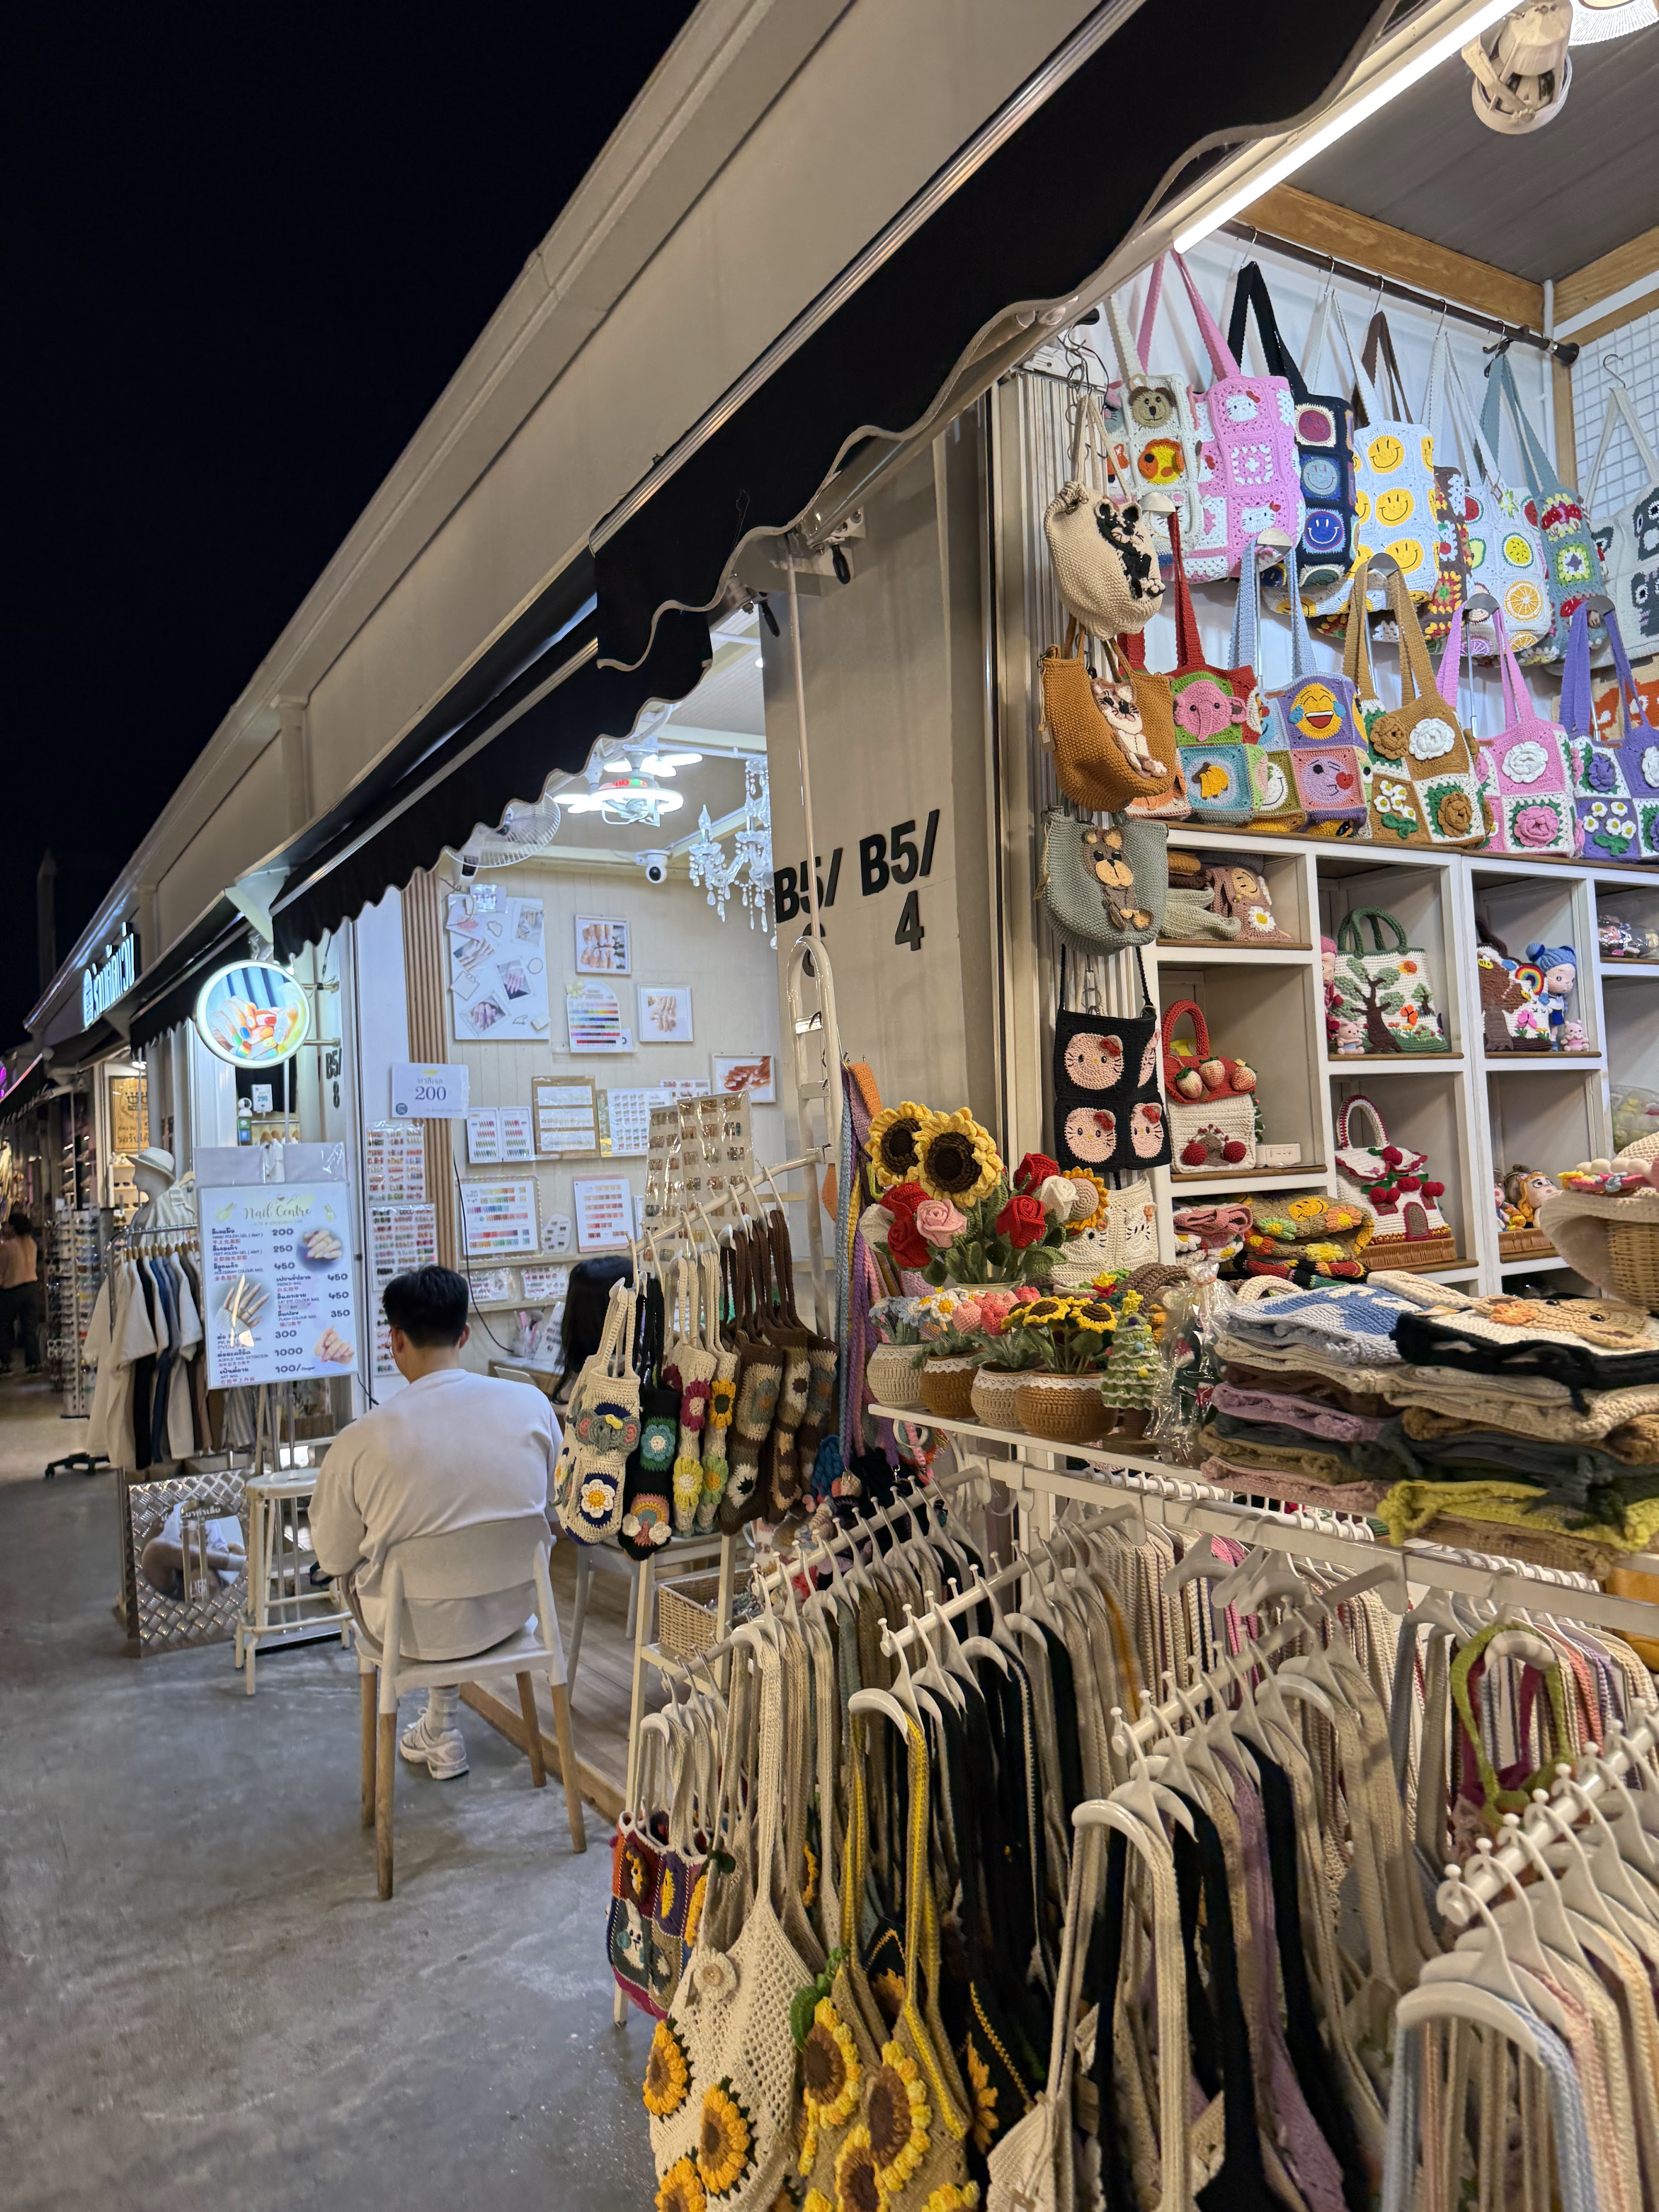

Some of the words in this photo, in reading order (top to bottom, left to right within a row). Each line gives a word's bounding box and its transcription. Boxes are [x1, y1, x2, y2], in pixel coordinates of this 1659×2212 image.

[860, 809, 940, 896] B5/
[774, 847, 843, 924] B5/
[895, 890, 924, 951] 4
[326, 1048, 342, 1079] B5/
[333, 1081, 340, 1108] 8
[415, 1086, 447, 1100] 200
[331, 1309, 350, 1318] 350
[275, 1330, 297, 1338] 300
[275, 1347, 303, 1356] 1000
